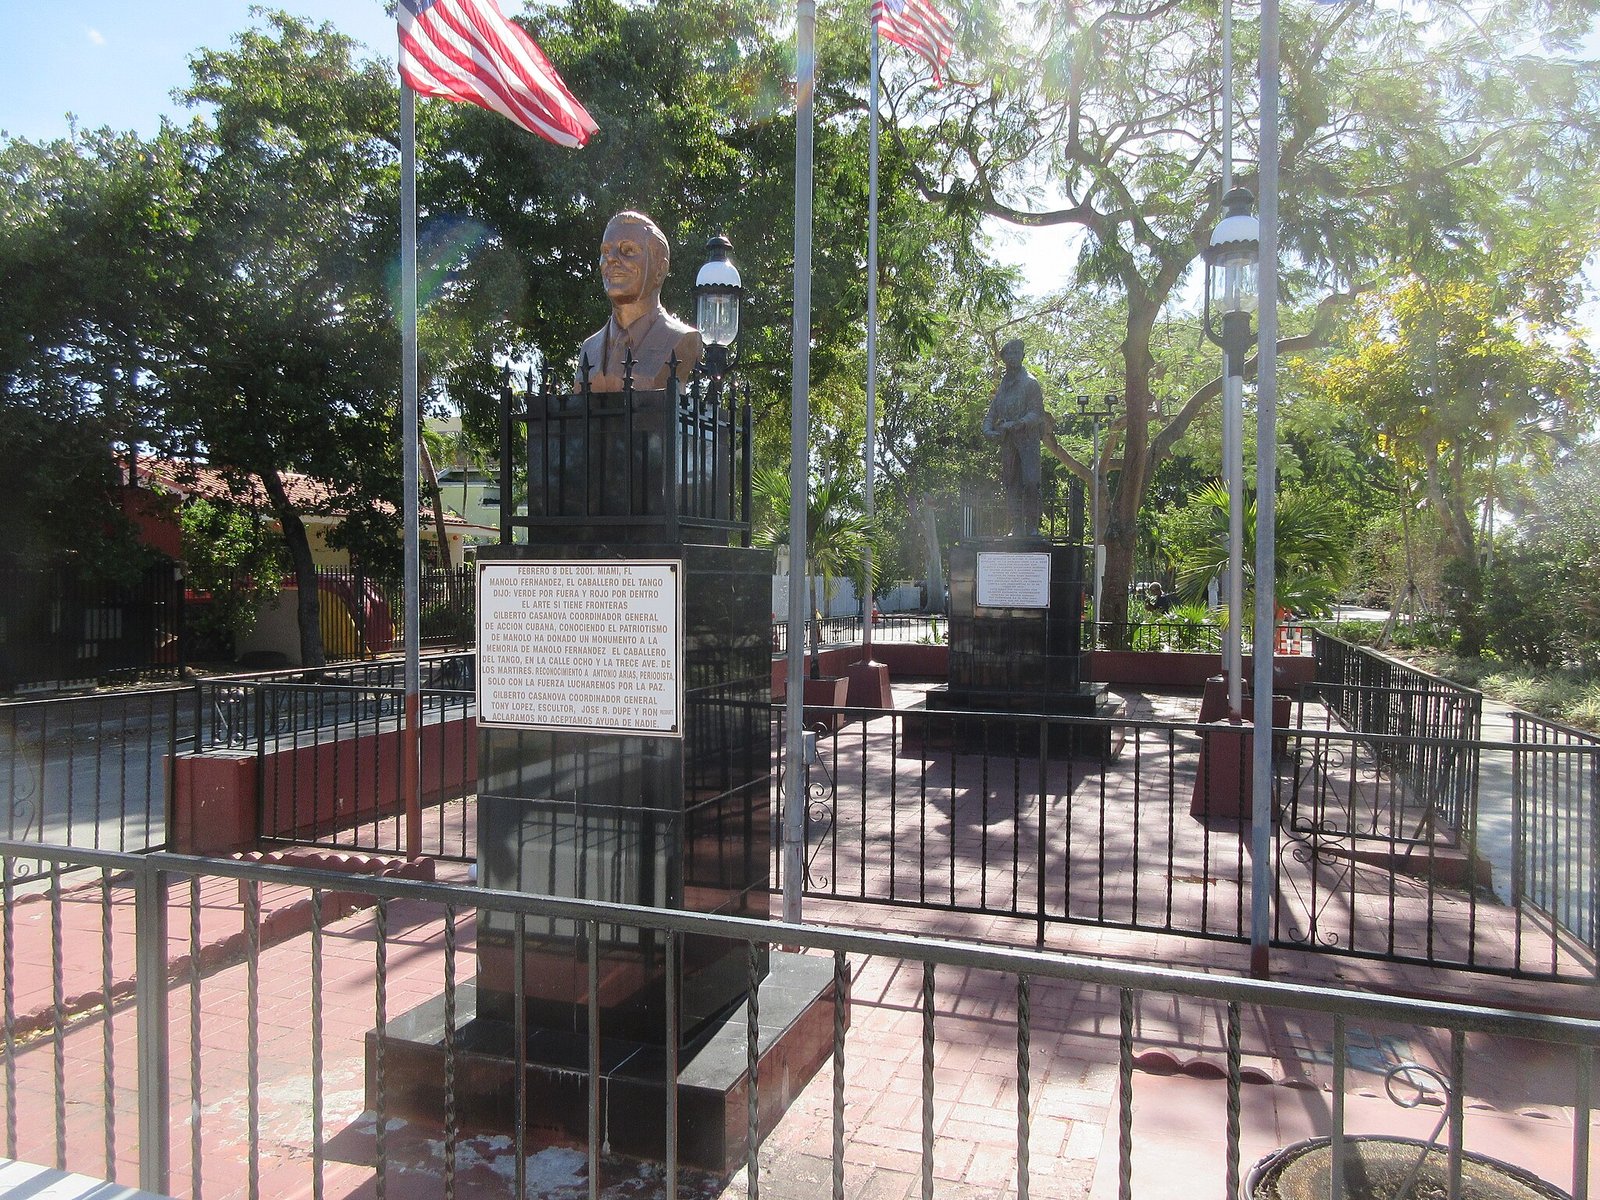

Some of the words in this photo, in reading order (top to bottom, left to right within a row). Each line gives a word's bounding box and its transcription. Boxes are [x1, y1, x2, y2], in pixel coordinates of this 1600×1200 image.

[518, 567, 549, 575] FEBRERO
[553, 567, 557, 575] 8
[560, 567, 573, 575] DEL
[489, 578, 518, 586] MANOLO
[578, 578, 619, 586] CABALLERO
[639, 579, 663, 587] TANGO
[612, 590, 626, 598] POR
[630, 590, 659, 598] DENTRO
[554, 601, 561, 609] SI
[563, 601, 583, 609] TIENE
[586, 601, 628, 609] FRONTERAS
[529, 612, 567, 620] CASANOVA
[570, 612, 622, 621] COORDINADOR
[625, 613, 658, 621] GENERAL
[559, 624, 605, 632] CONOCIENDO
[620, 625, 668, 633] PATRIOTISMO
[503, 634, 531, 642] MANOLO
[535, 634, 544, 642] HA
[547, 634, 577, 642] DONADO
[580, 635, 589, 643] UN
[592, 636, 637, 644] MONUMENTO
[521, 645, 530, 653] DE
[533, 645, 562, 653] MANOLO
[565, 646, 606, 655] FERNANDEZ
[623, 648, 666, 656] CABALLERO
[483, 655, 495, 663] DEL
[525, 656, 534, 664] EN
[549, 657, 570, 665] CALLE
[573, 658, 593, 666] OCHO
[616, 659, 639, 667] TRECE
[661, 660, 671, 668] DE
[483, 666, 495, 674] LOS
[535, 668, 582, 677] RECONOCIMIENTO
[584, 669, 588, 677] A
[488, 677, 506, 685] SOLO
[508, 678, 523, 686] CON
[538, 679, 564, 687] FUERZA
[568, 680, 615, 689] LUCHAREMOS
[618, 682, 633, 690] POR
[493, 691, 525, 699] GILBERTO
[528, 692, 566, 701] CASANOVA
[569, 693, 621, 703] COORDINADOR
[624, 696, 658, 705] GENERAL
[492, 702, 509, 710] TONY
[581, 706, 599, 714] JOSE
[613, 707, 631, 715] DUPE
[642, 708, 658, 716] RON
[492, 713, 535, 722] ACLARAMOS
[550, 715, 592, 725] ACEPTAMOS
[596, 718, 621, 726] AYUDA
[622, 719, 632, 727] DE
